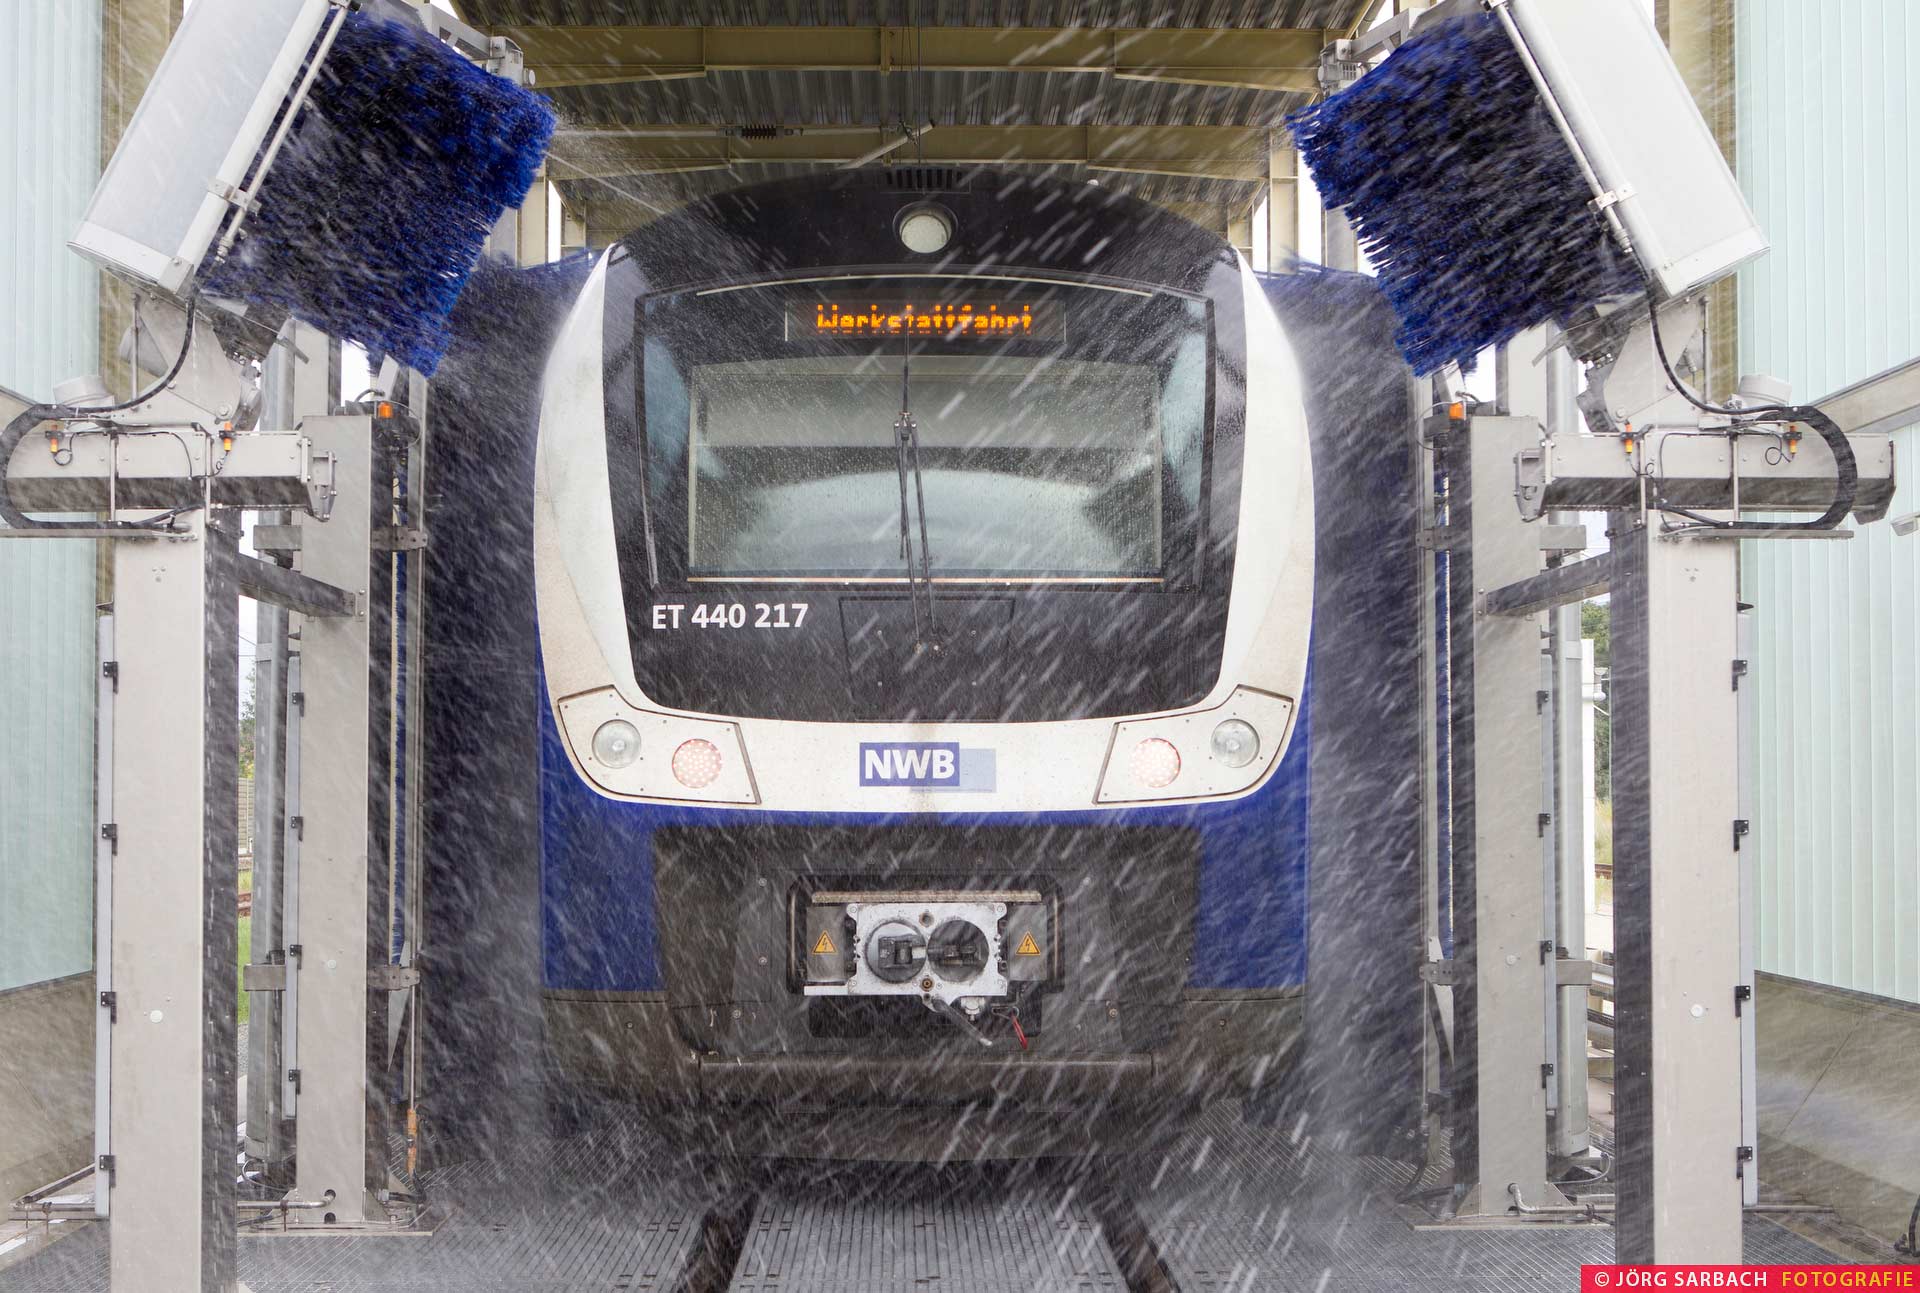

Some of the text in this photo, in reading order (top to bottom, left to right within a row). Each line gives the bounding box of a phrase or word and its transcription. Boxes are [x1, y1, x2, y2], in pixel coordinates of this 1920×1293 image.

[653, 604, 808, 629] ET 440 217
[865, 749, 955, 780] NWB
